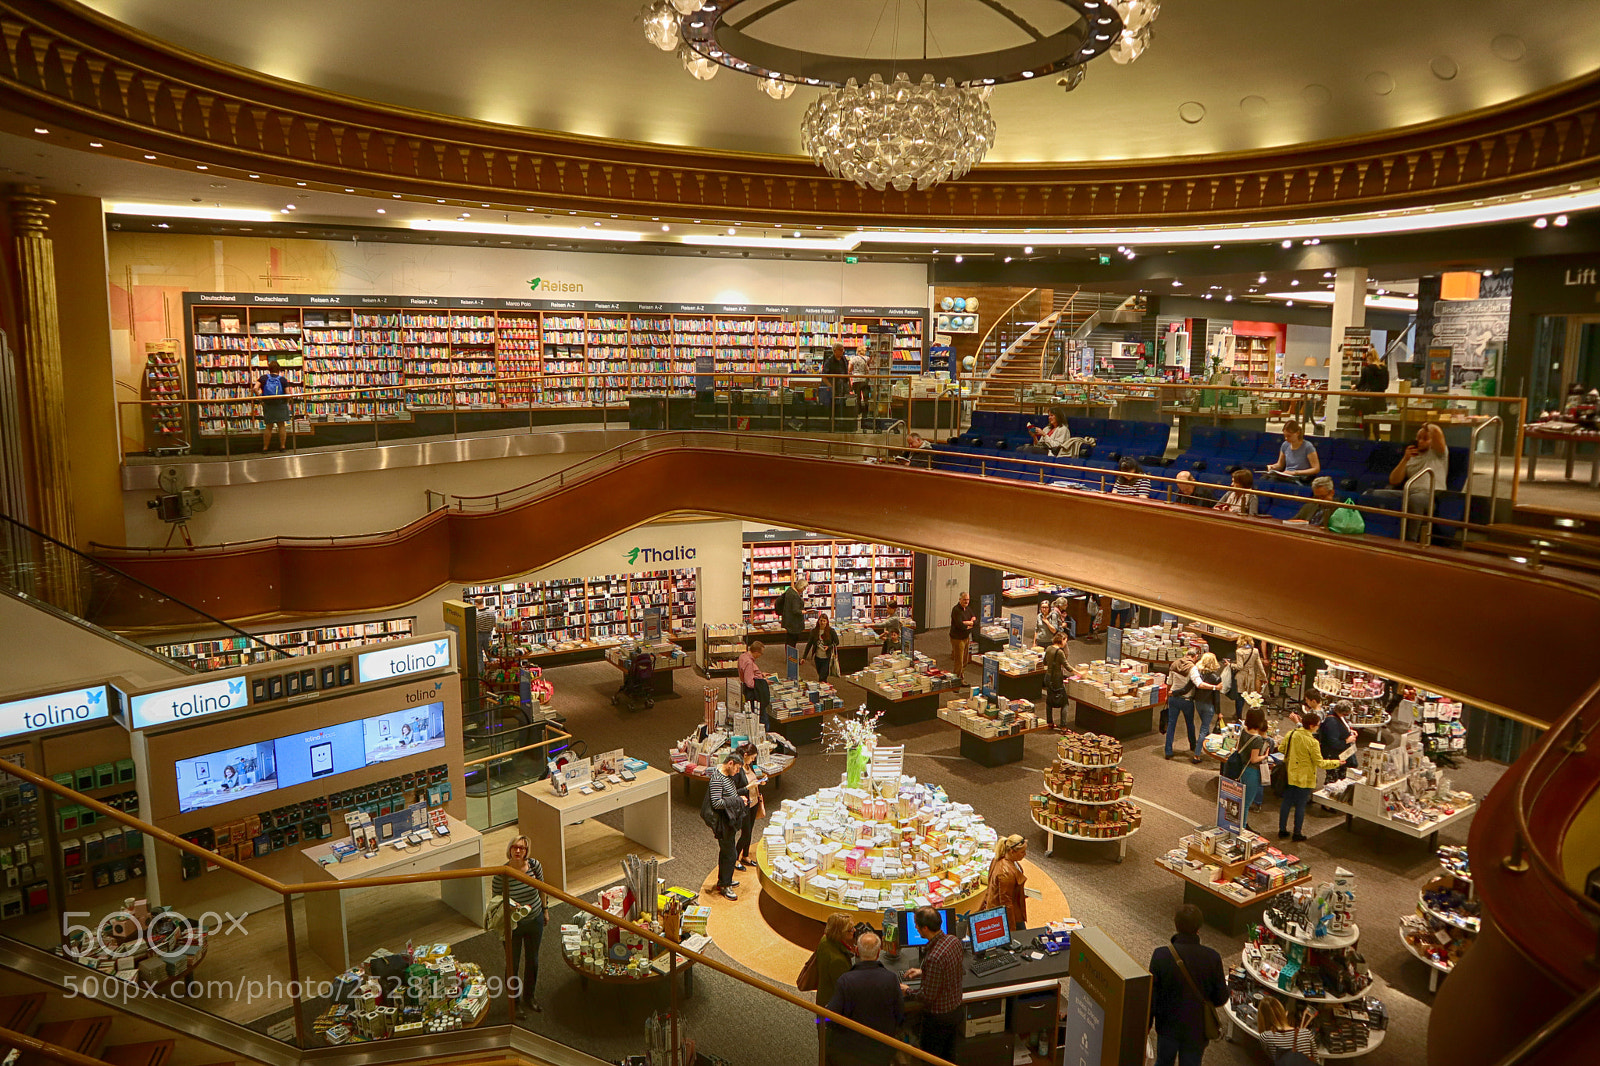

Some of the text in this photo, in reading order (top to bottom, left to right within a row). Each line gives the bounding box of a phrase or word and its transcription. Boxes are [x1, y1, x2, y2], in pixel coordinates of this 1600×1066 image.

[1565, 268, 1596, 285] Lift
[541, 279, 584, 292] Reisen
[200, 294, 236, 302] Deutschland
[641, 545, 696, 563] Thalia
[390, 653, 436, 674] tolino
[405, 689, 436, 703] tolino
[171, 694, 231, 718] tolino
[23, 704, 90, 729] tolino
